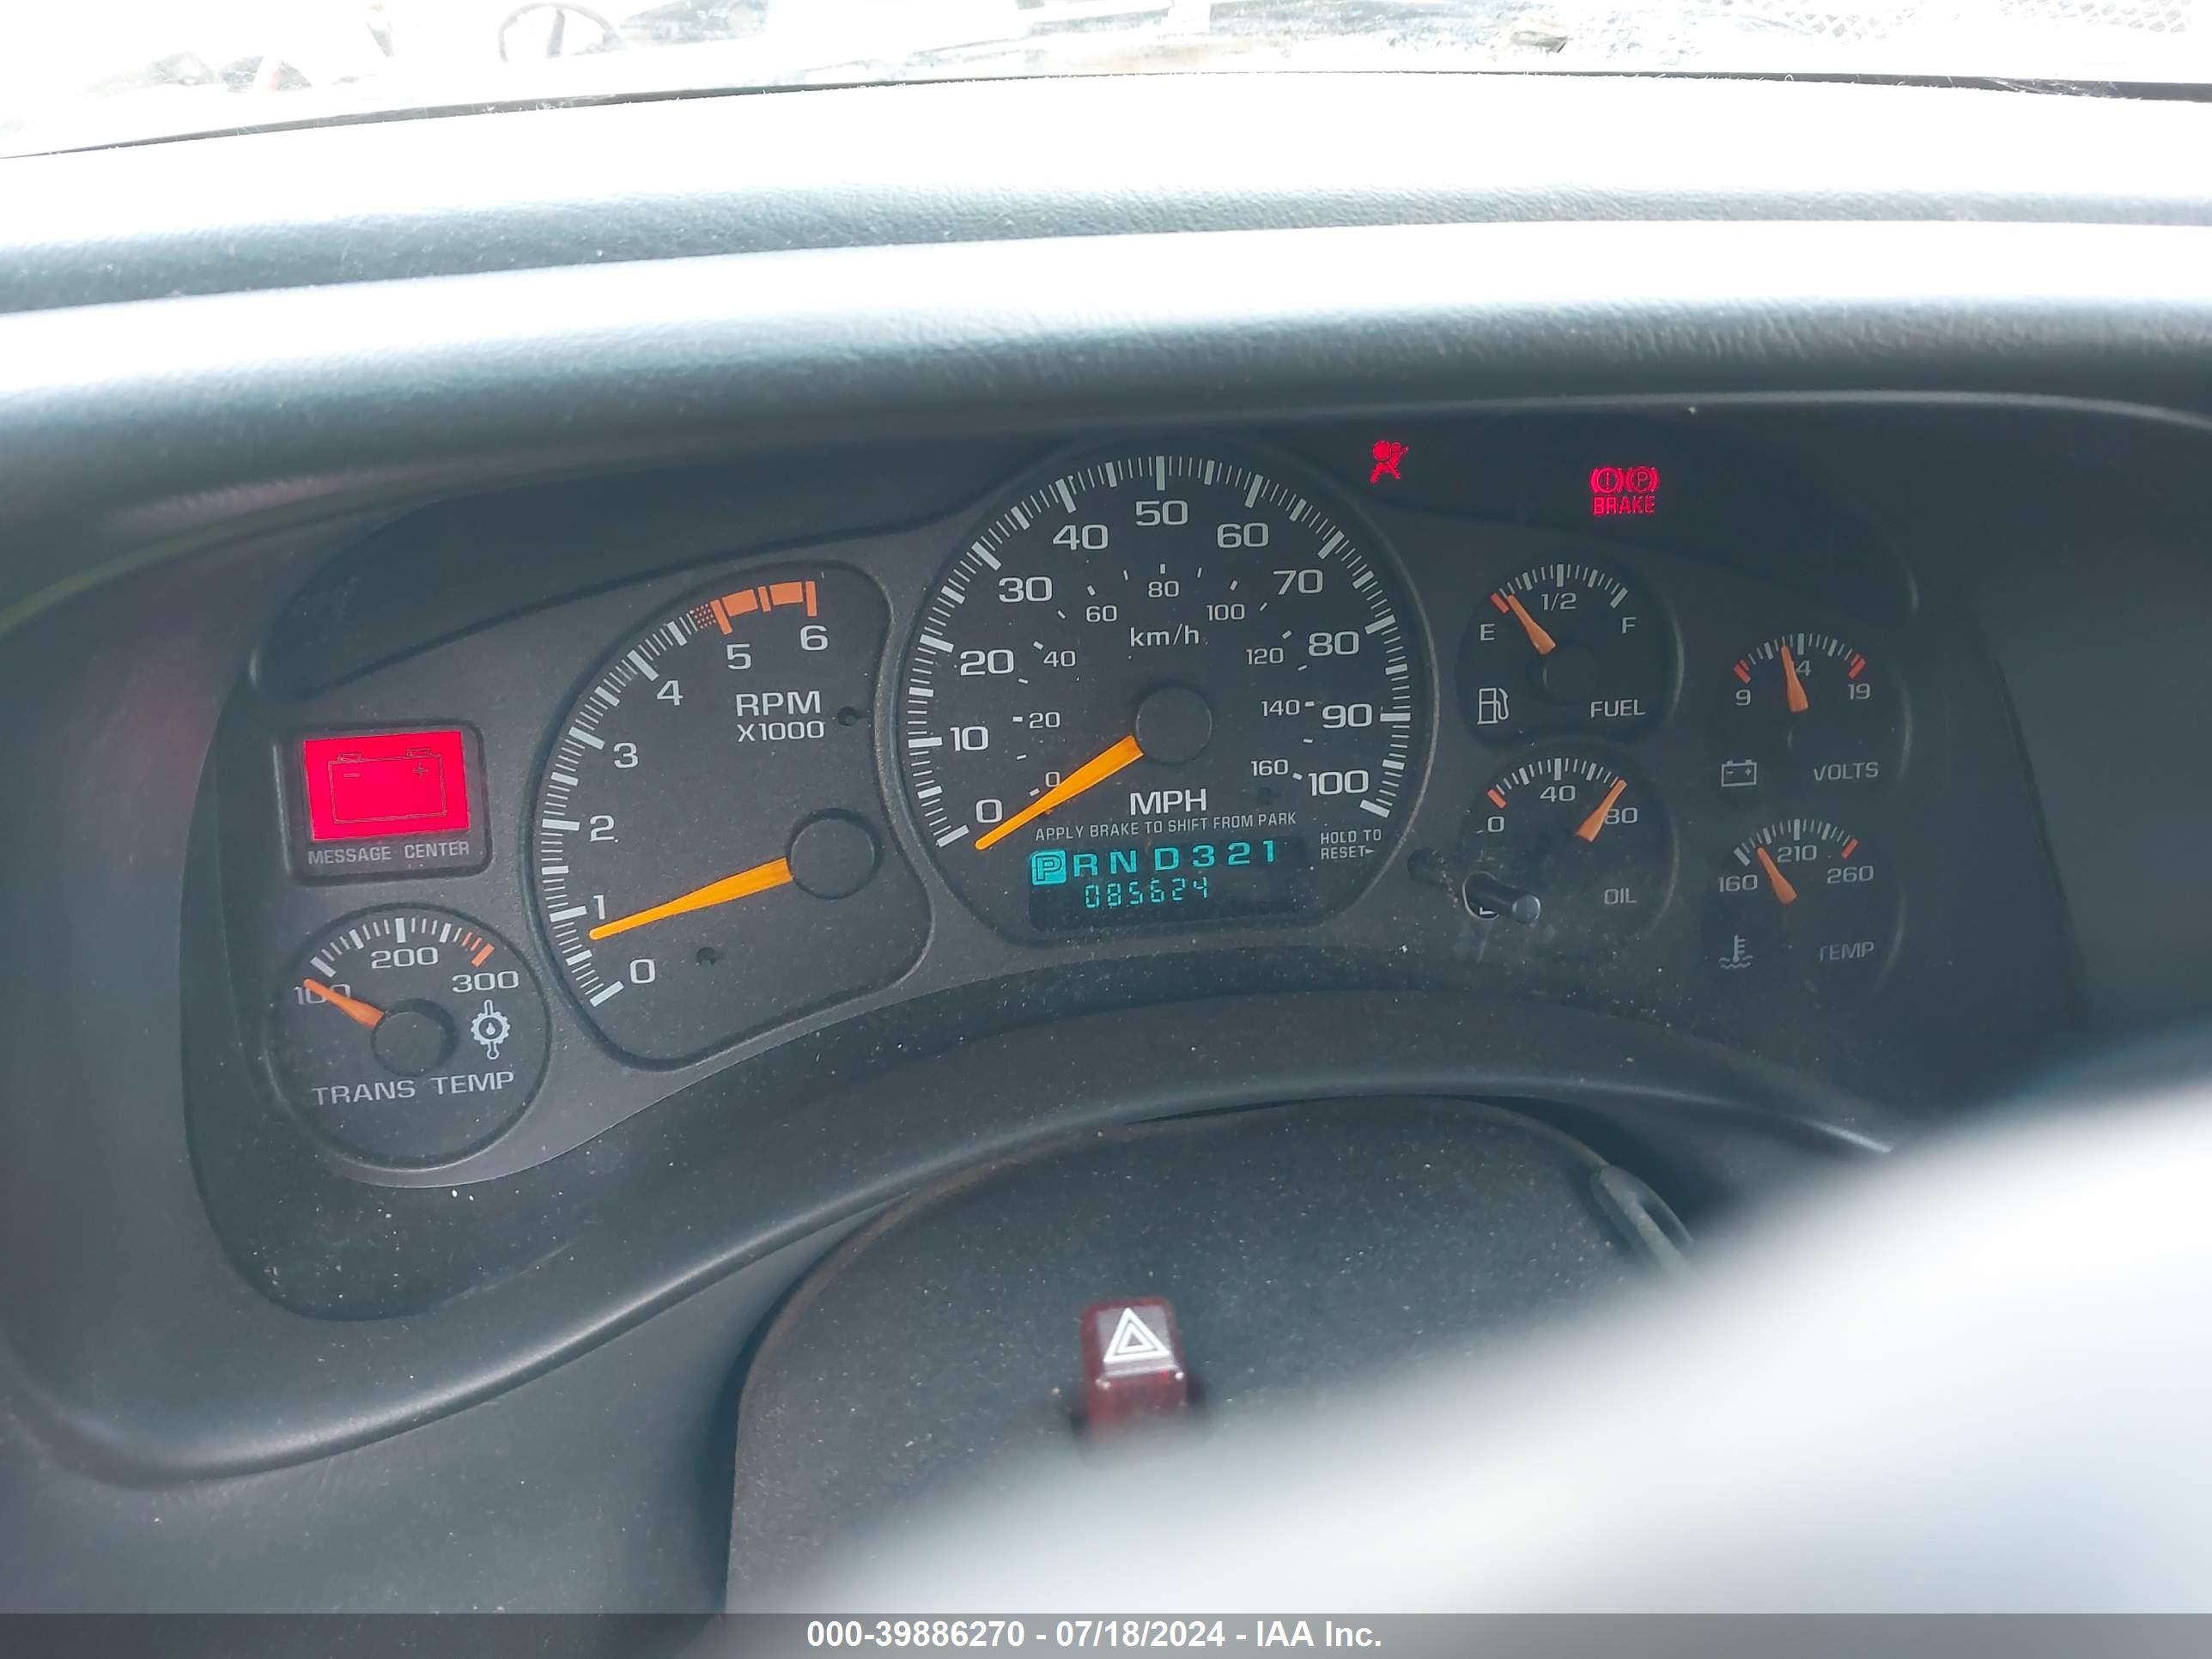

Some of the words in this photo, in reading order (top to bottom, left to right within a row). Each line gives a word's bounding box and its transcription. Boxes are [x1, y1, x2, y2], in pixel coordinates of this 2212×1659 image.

[1135, 500, 1188, 526] 50
[1593, 495, 1655, 515] BRAKE
[1052, 524, 1108, 550] 40
[1216, 523, 1268, 548] 60
[998, 576, 1052, 603] 30
[1147, 581, 1179, 598] 80
[1273, 569, 1322, 594] 70
[1206, 604, 1245, 620] 100
[1541, 592, 1577, 611] 1/2
[1086, 605, 1117, 622] 60
[1129, 623, 1200, 647] km/h
[1480, 623, 1495, 641] E
[1622, 617, 1635, 634] F
[800, 626, 828, 652] 6
[1308, 631, 1359, 656] 80
[726, 644, 751, 670] 5
[959, 649, 1014, 676] 20
[1043, 651, 1076, 667] 40
[1246, 647, 1283, 665] 120
[657, 680, 683, 706] 4
[1735, 690, 1751, 706] 9
[1849, 683, 1870, 700] 19
[735, 691, 821, 716] RPM
[1261, 699, 1299, 716] 140
[1590, 699, 1645, 718] FUEL
[1029, 712, 1060, 729] 20
[1322, 703, 1372, 729] 90
[737, 721, 824, 742] X1000
[950, 726, 988, 751] 10
[614, 743, 638, 768] 3
[1251, 759, 1288, 776] 160
[1814, 762, 1878, 781] VOLTS
[1045, 772, 1060, 788] 0
[1308, 769, 1368, 796] 100
[1129, 788, 1206, 816] MPH
[1540, 785, 1576, 802] 40
[975, 799, 1003, 824] 0
[1604, 807, 1638, 824] 80
[590, 816, 615, 841] 2
[1035, 825, 1084, 842] APPLY
[1089, 822, 1139, 839] BRAKE
[1145, 820, 1164, 835] TO
[1167, 817, 1207, 833] SHIFT
[1212, 815, 1254, 830] FROM
[1258, 811, 1297, 828] PARK
[1487, 817, 1504, 833] 0
[1321, 831, 1356, 844] HOLD
[1363, 829, 1381, 842] TO
[308, 846, 392, 865] MESSAGE
[404, 842, 470, 859] CENTER
[1073, 854, 1098, 877] R
[1109, 850, 1137, 874] N
[1153, 848, 1179, 871] D
[1191, 844, 1214, 867] 3
[1227, 842, 1251, 865] 2
[1262, 840, 1275, 863] 1
[1321, 846, 1365, 860] RESET
[1778, 844, 1816, 863] 210
[1718, 874, 1758, 892] 160
[1826, 866, 1874, 884] 260
[1085, 876, 1208, 909] 085624
[1604, 888, 1637, 905] OIL
[593, 895, 605, 919] 1
[371, 946, 438, 969] 200
[1819, 942, 1874, 962] TEMP
[452, 970, 519, 993] 300
[630, 959, 655, 983] 0
[312, 1080, 416, 1105] TRANS
[431, 1071, 514, 1094] TEMP
